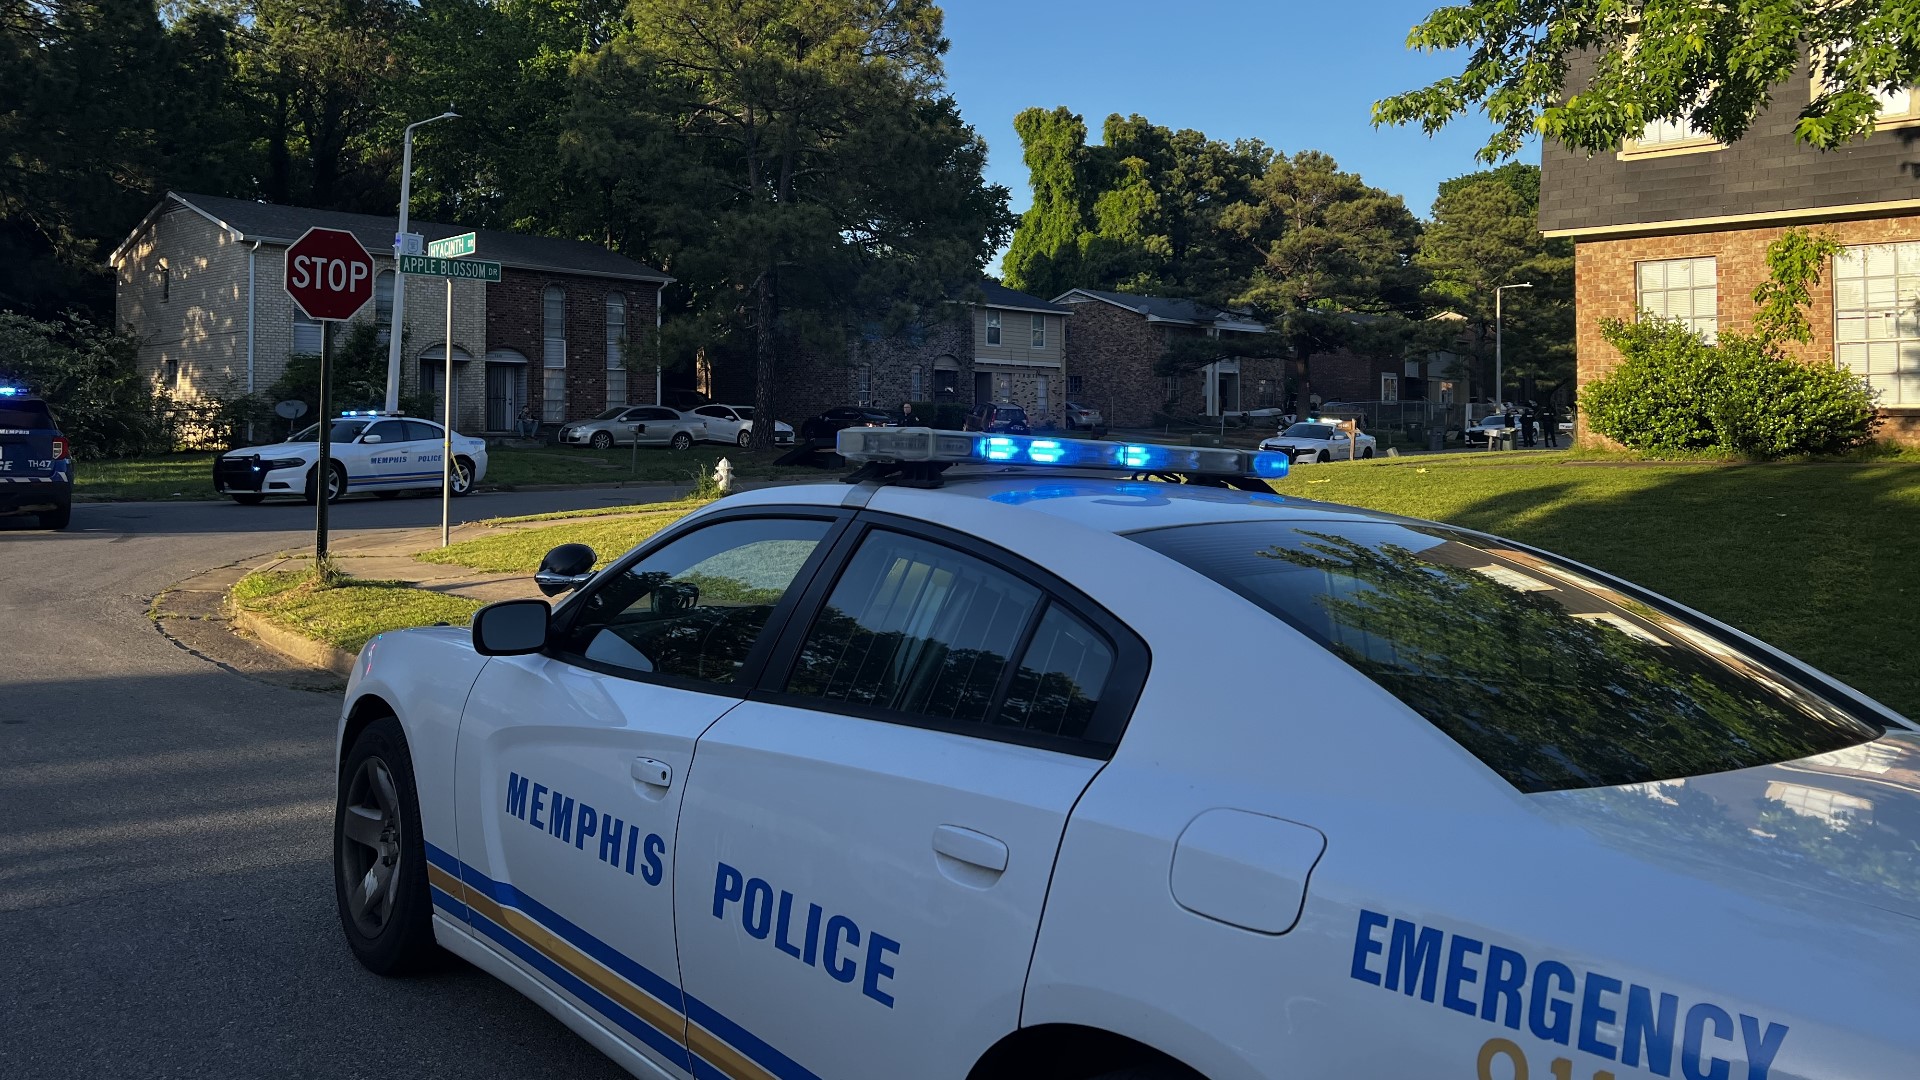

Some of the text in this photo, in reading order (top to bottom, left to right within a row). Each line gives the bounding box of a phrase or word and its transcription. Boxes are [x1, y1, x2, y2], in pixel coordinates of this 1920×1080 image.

[430, 238, 464, 258] HYACINTH
[292, 254, 368, 293] STOP
[403, 256, 498, 278] APPLE BLOSSOM DR
[28, 459, 52, 468] TH47
[370, 454, 442, 465] MEMPHIS POLICE
[505, 771, 901, 1010] MEMPHIS POLICE
[1350, 908, 1790, 1080] EMERGENCY
